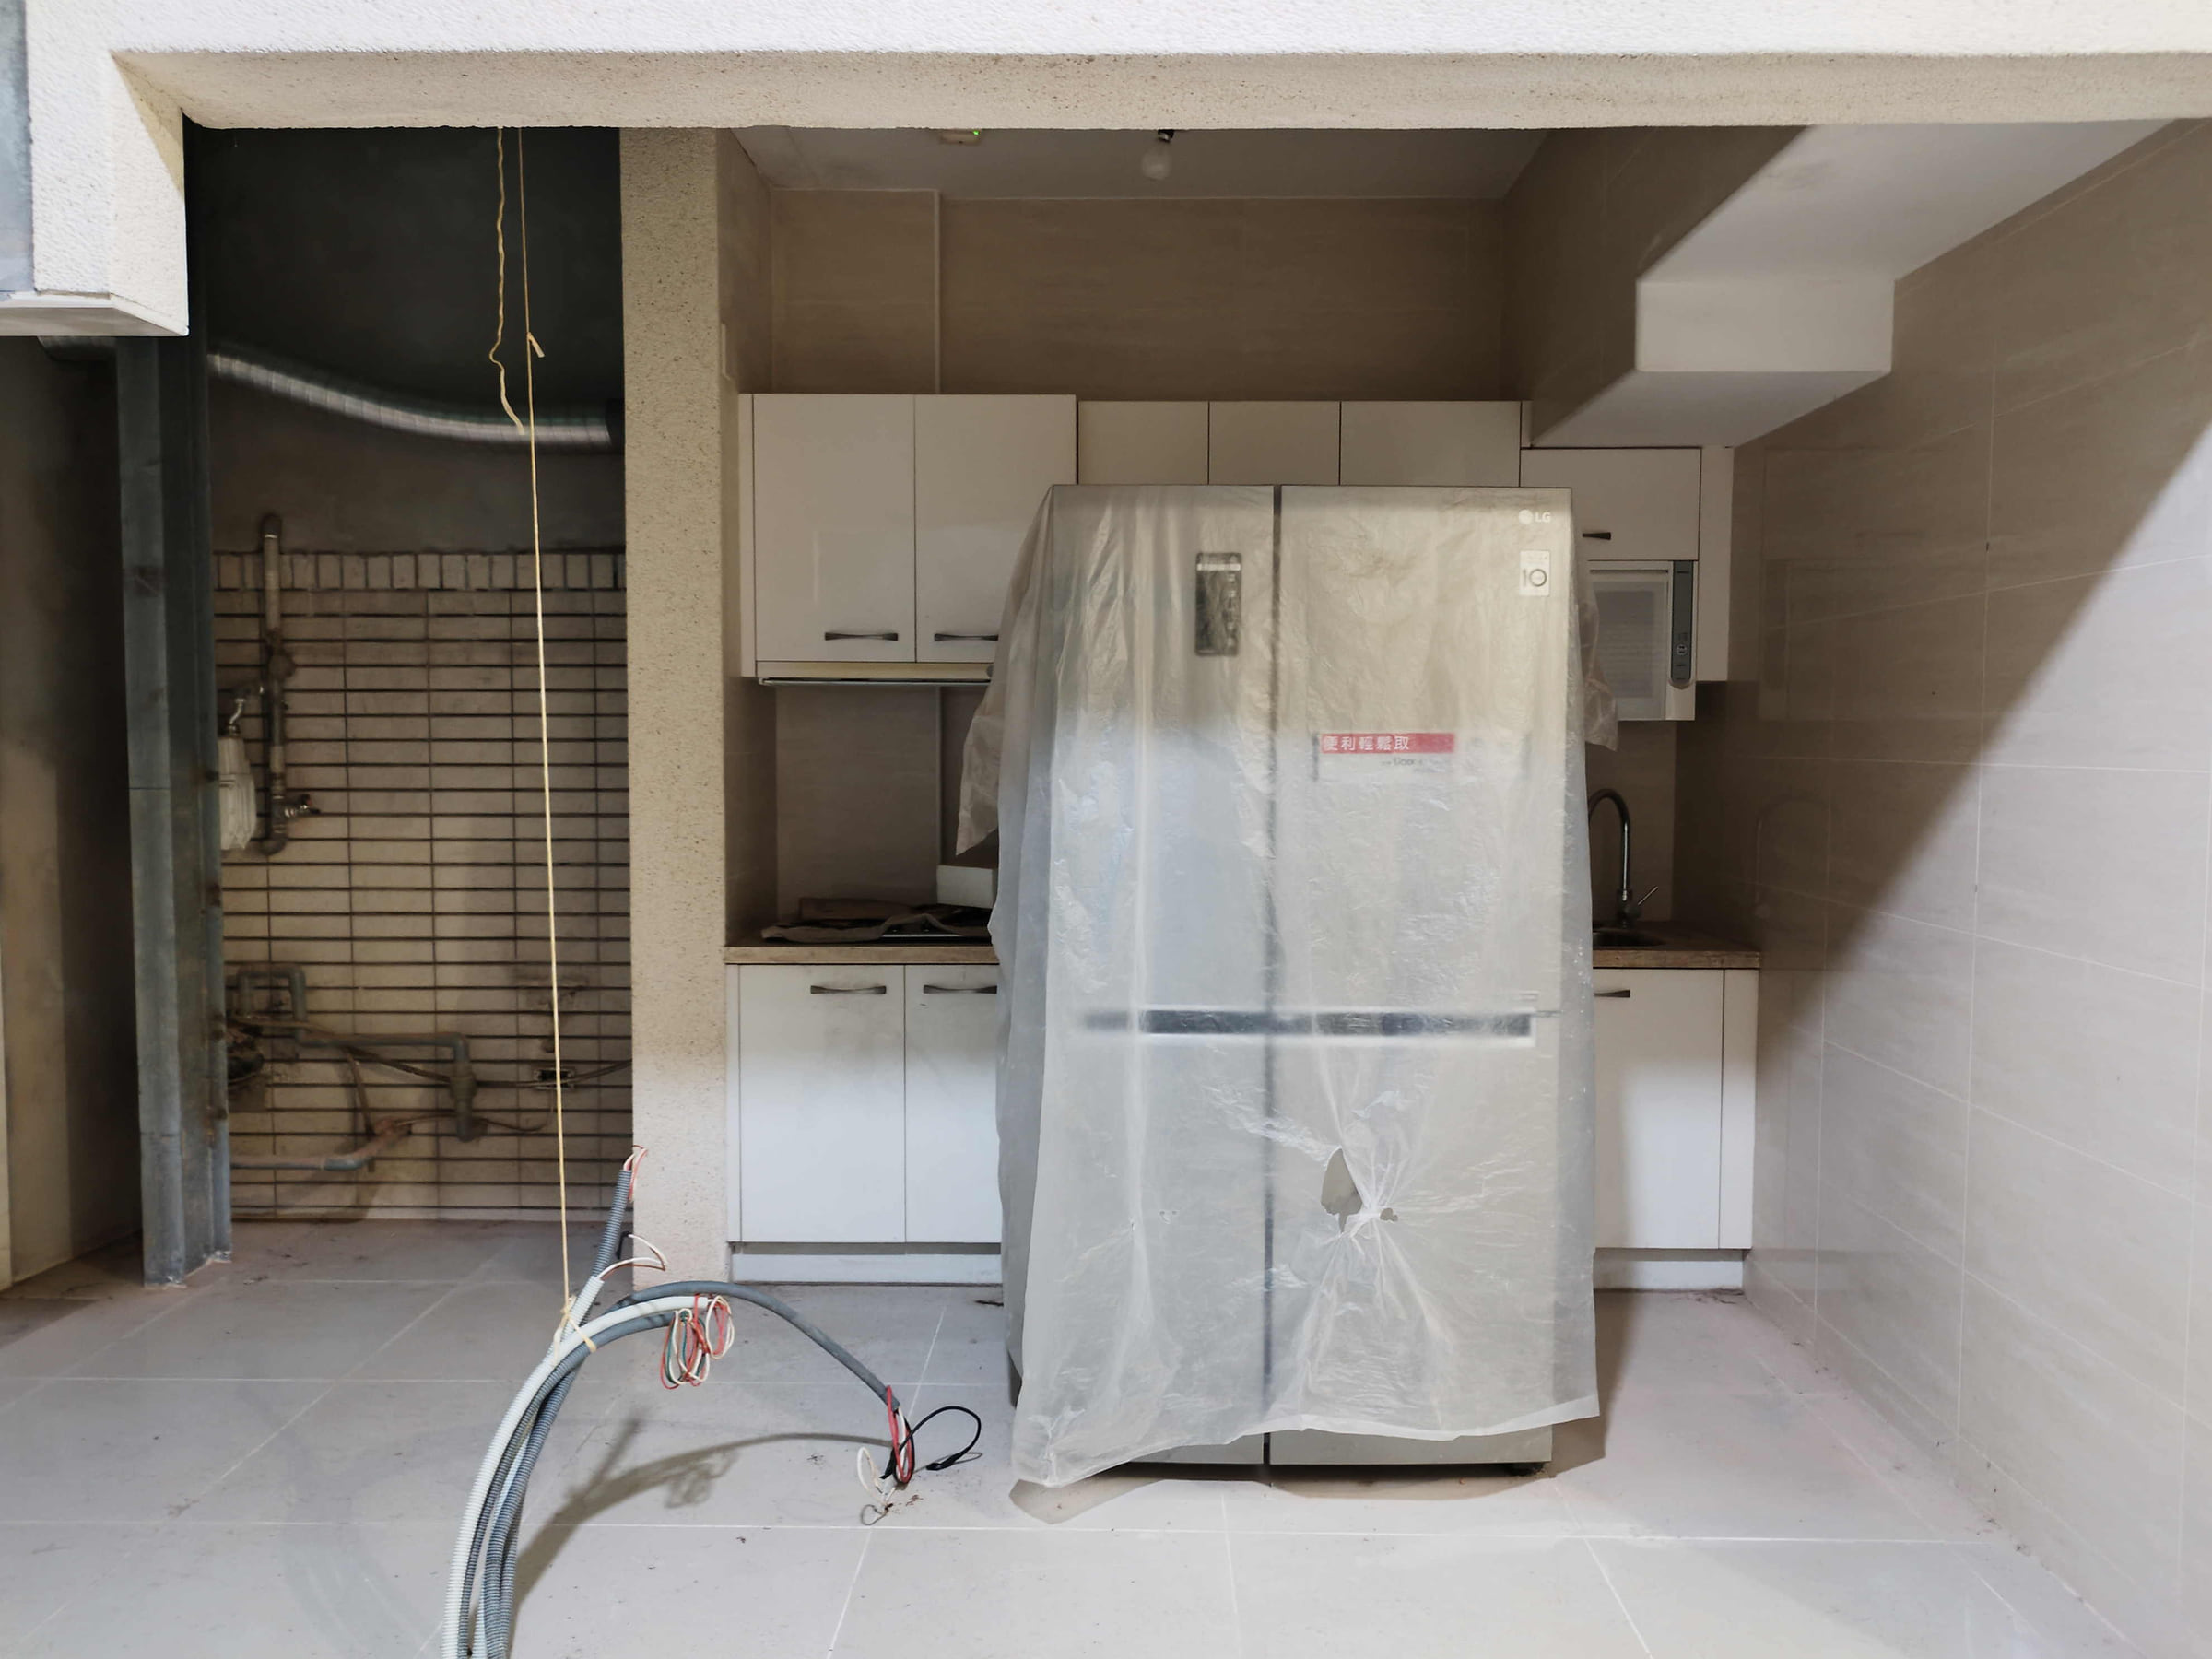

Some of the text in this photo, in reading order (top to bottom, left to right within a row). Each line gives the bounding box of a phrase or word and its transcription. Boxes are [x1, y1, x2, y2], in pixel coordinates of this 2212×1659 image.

[1535, 512, 1552, 523] LG
[1323, 735, 1410, 751] 便利輕鬆取
